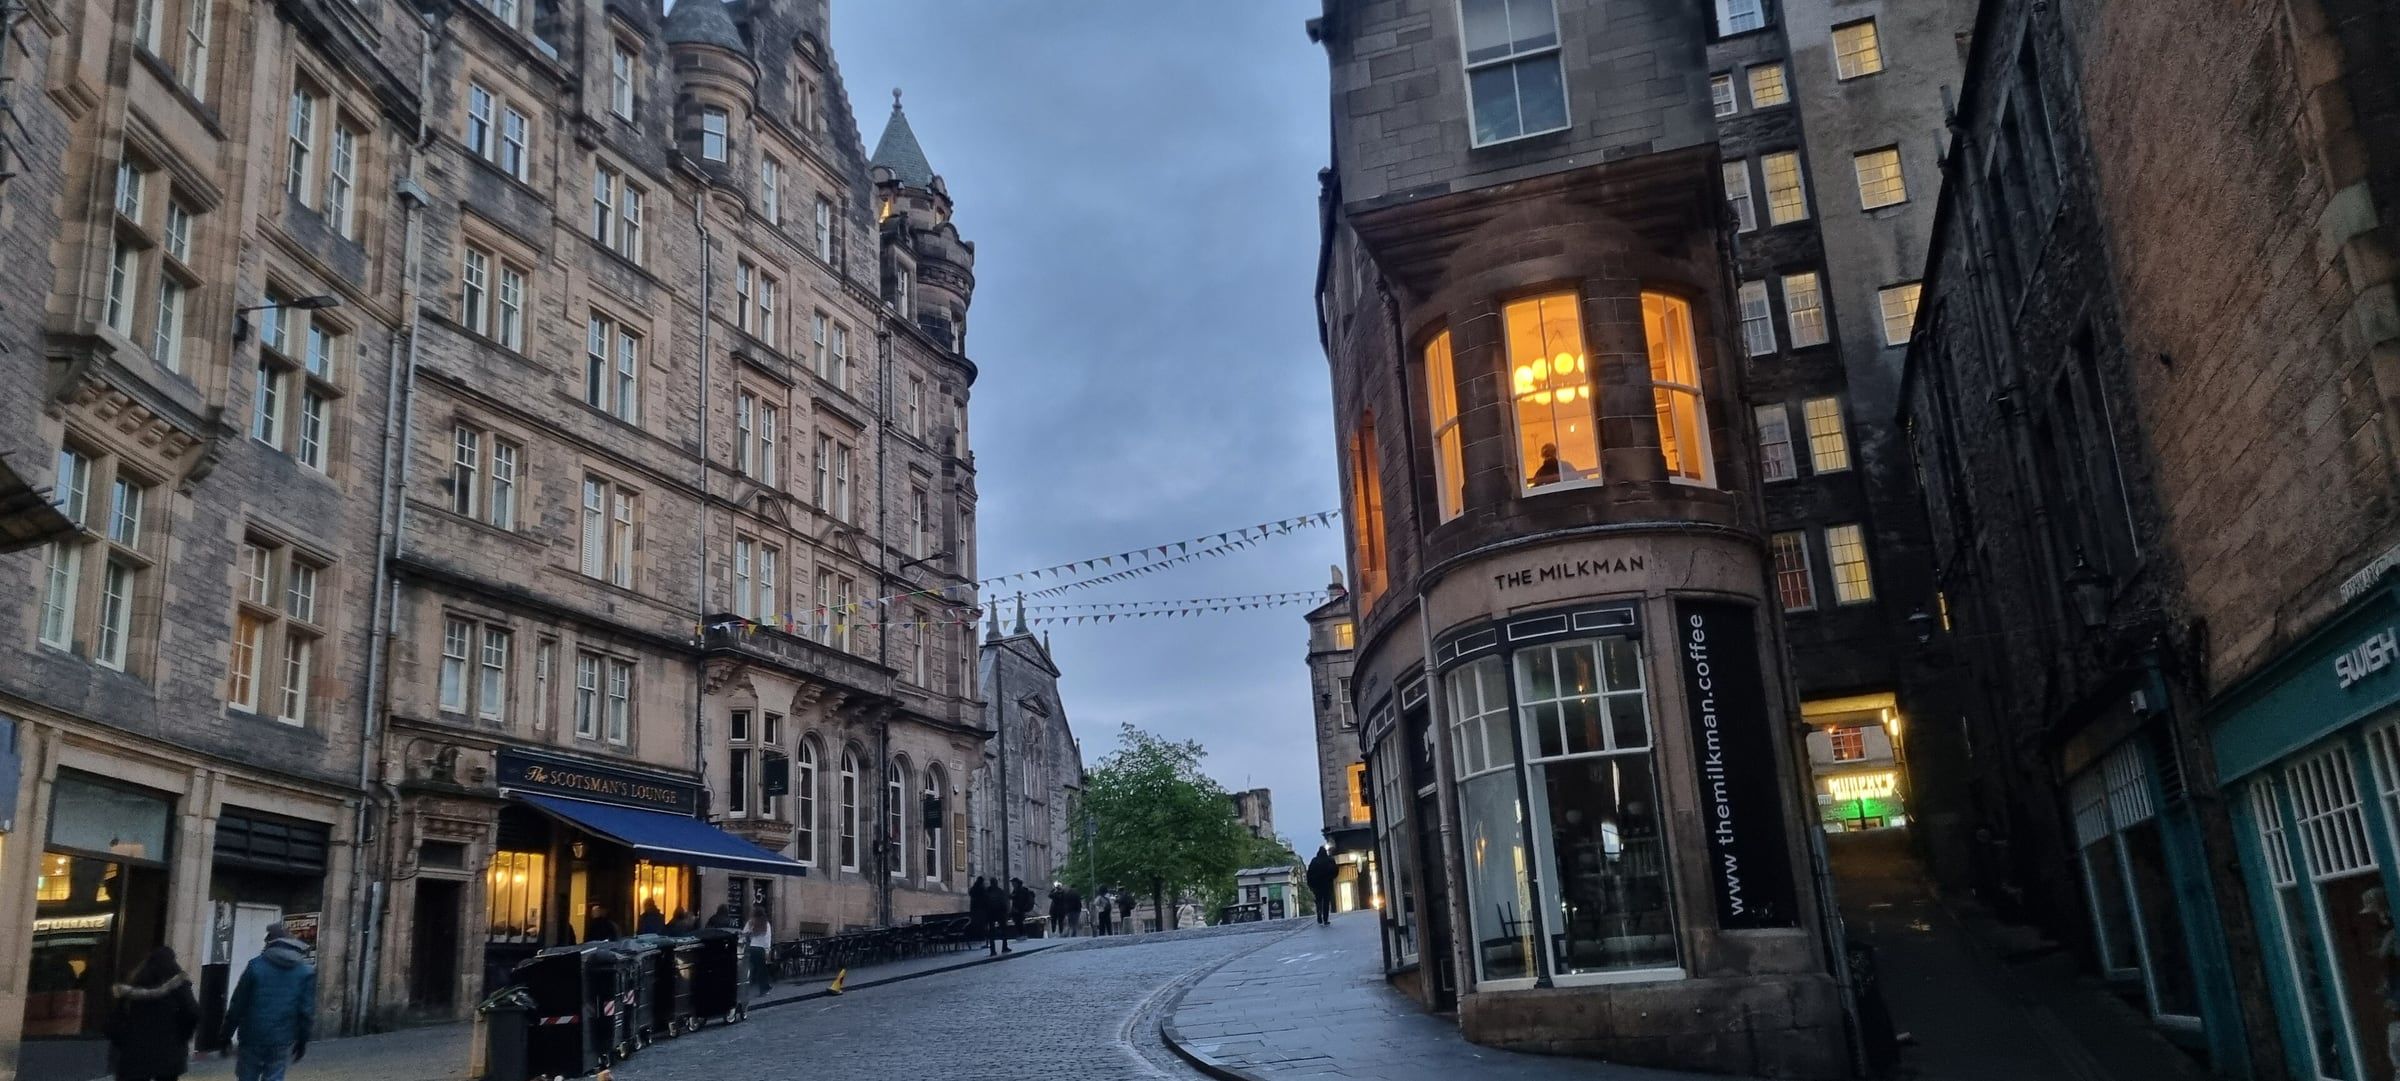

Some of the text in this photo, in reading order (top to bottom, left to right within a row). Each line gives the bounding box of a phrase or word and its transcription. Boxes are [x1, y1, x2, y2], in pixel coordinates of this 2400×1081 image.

[1494, 555, 1645, 590] THE MILKMAN
[2335, 627, 2400, 689] SWISH
[1690, 614, 1734, 846] themilkman.coffee
[524, 765, 677, 804] The SCOTSMAN'S LOUNGE
